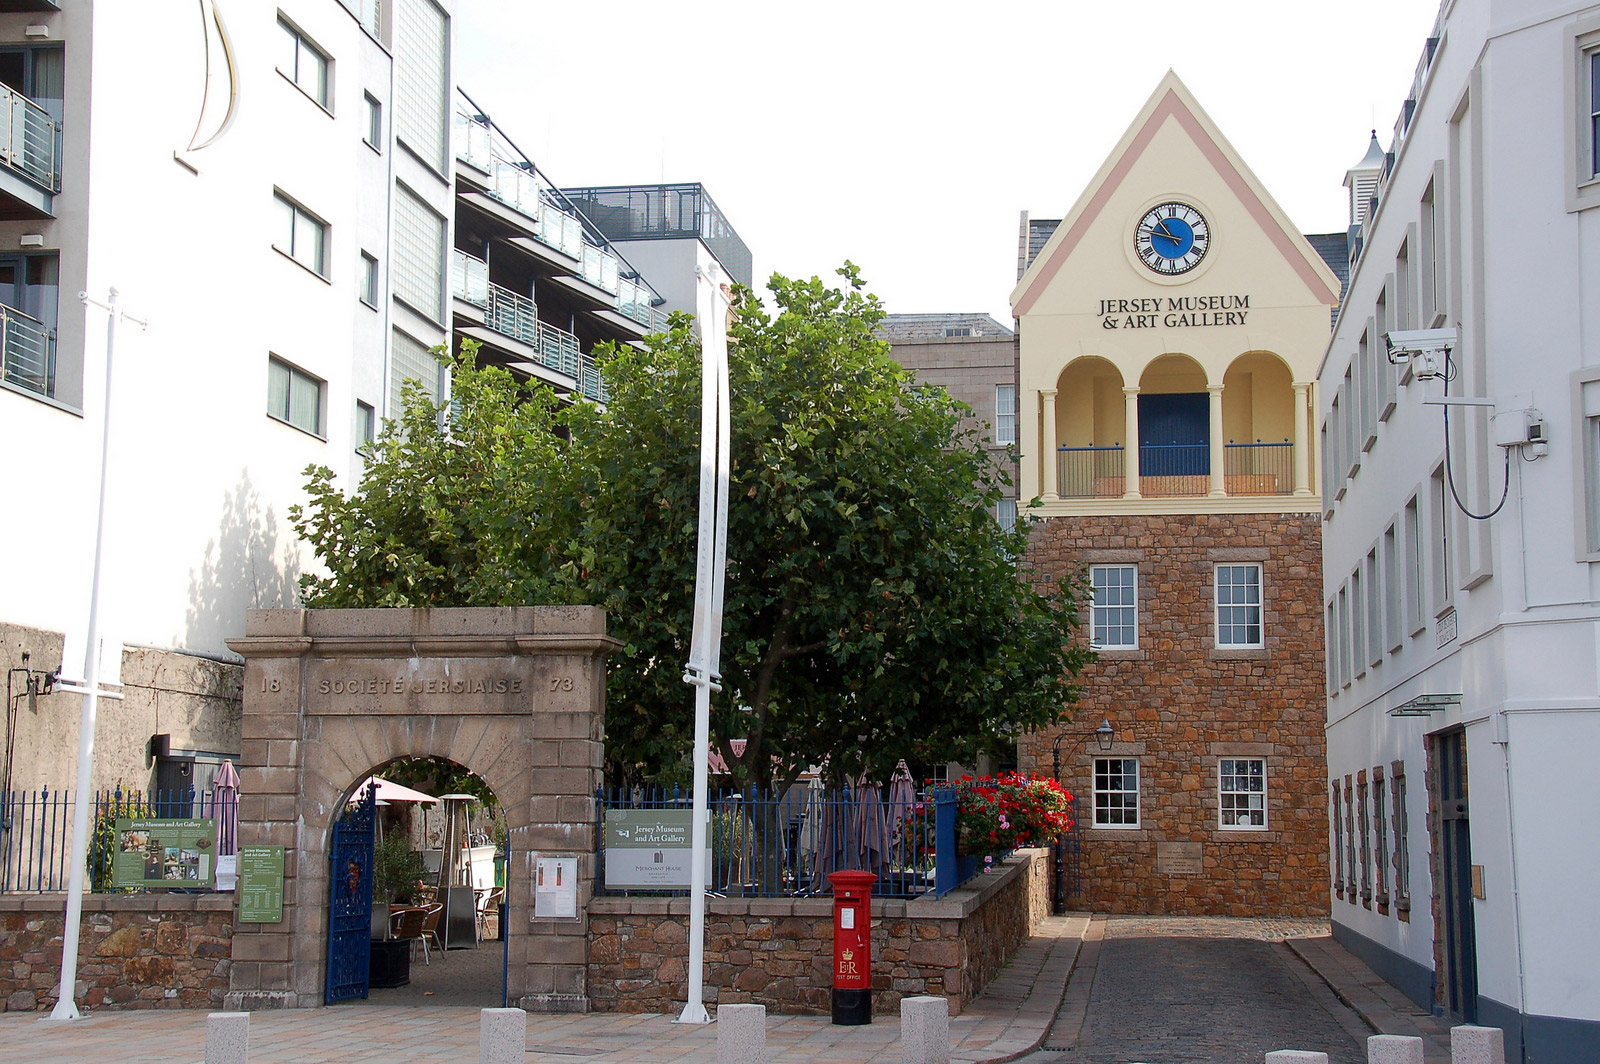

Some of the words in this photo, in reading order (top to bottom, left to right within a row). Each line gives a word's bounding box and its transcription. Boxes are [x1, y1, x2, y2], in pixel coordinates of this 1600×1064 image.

[1097, 297, 1163, 317] JERSEY
[1168, 294, 1250, 311] MUSEUM
[1102, 315, 1119, 330] &
[1123, 314, 1159, 329] ART
[1163, 311, 1249, 328] GALLERY
[261, 678, 282, 694] 18
[318, 676, 404, 695] SOCIÉTÉ
[411, 677, 523, 695] JERSIAISE
[549, 677, 574, 692] 73
[635, 825, 655, 835] Jersey
[655, 825, 685, 833] Museum
[634, 834, 647, 842] and
[648, 834, 660, 842] Art
[661, 834, 686, 844] Gallery
